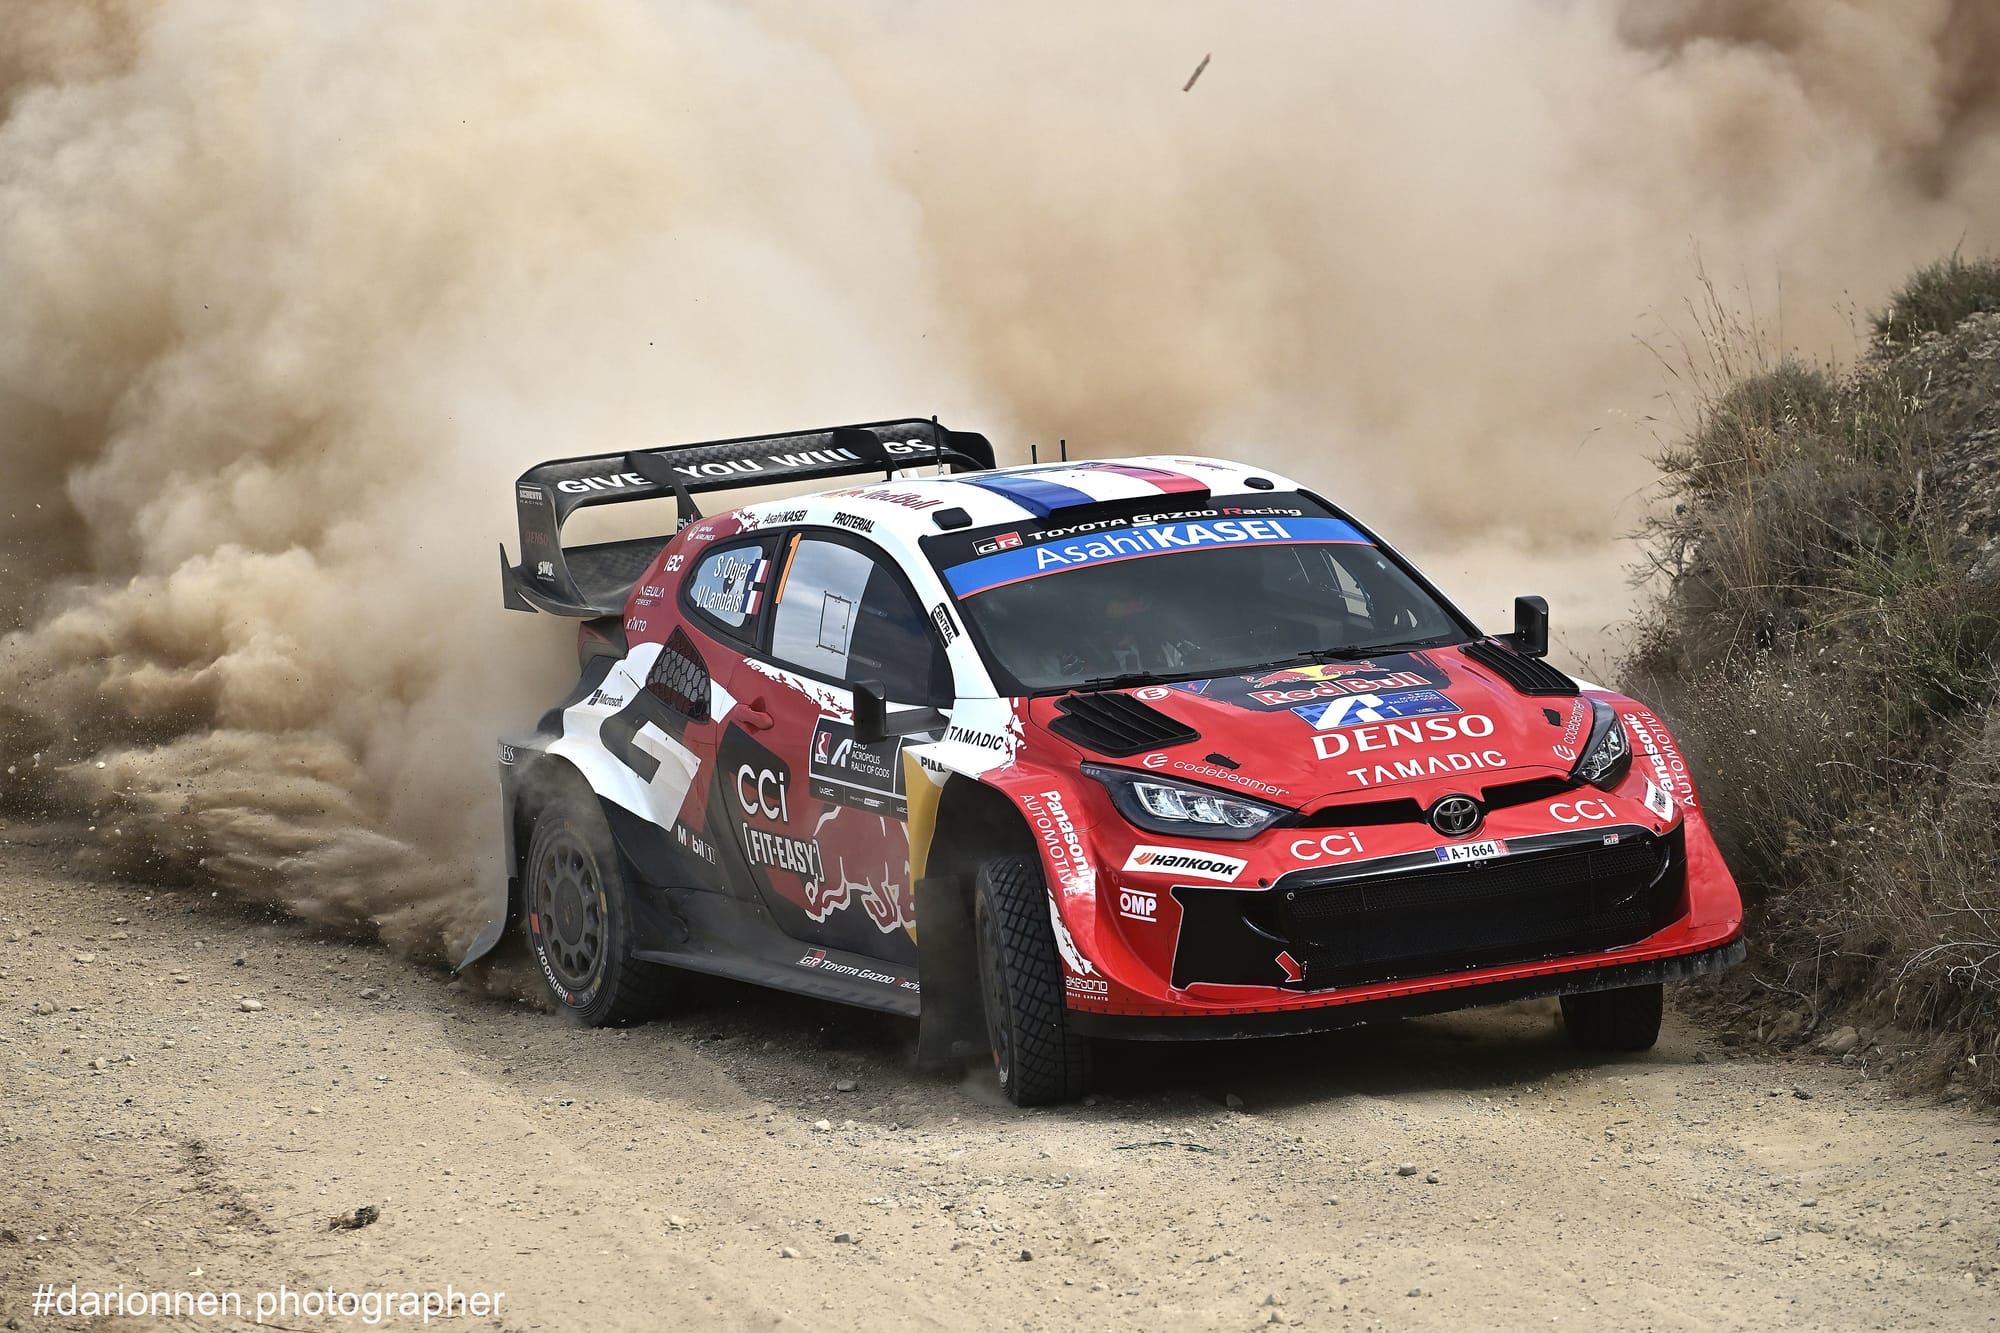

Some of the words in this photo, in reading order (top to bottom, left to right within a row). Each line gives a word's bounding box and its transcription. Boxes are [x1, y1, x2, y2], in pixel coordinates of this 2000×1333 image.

[557, 472, 652, 494] GIVE
[673, 458, 764, 479] YOU
[832, 511, 875, 533] PROTERIAL
[976, 536, 1021, 552] GR
[1027, 517, 1128, 541] TOYOTA
[1131, 508, 1218, 527] GAZOO
[1222, 506, 1302, 516] Racing
[1036, 519, 1292, 570] AsahiKASEI
[934, 604, 954, 644] CENTRAL
[598, 693, 624, 707] Microsoft
[1251, 681, 1347, 705] Red
[1341, 671, 1432, 692] Bull
[949, 726, 1004, 750] TAMADIC
[1311, 714, 1494, 760] DENSO
[851, 751, 881, 764] ACROPOLIS
[851, 761, 867, 772] RALLY
[867, 765, 875, 774] OF
[875, 767, 890, 778] GODS
[1347, 750, 1507, 786] TAMADIC
[1637, 711, 1696, 807] AUTOMOTIVE
[737, 764, 788, 822] CCi
[1550, 799, 1616, 823] CCi
[1020, 795, 1078, 897] AUTOMOTIVE
[1290, 832, 1363, 861] CCi
[1452, 844, 1494, 859] A-7664
[1120, 893, 1157, 916] OMP
[821, 960, 859, 975] TOYOTA
[858, 969, 895, 984] GAZOO
